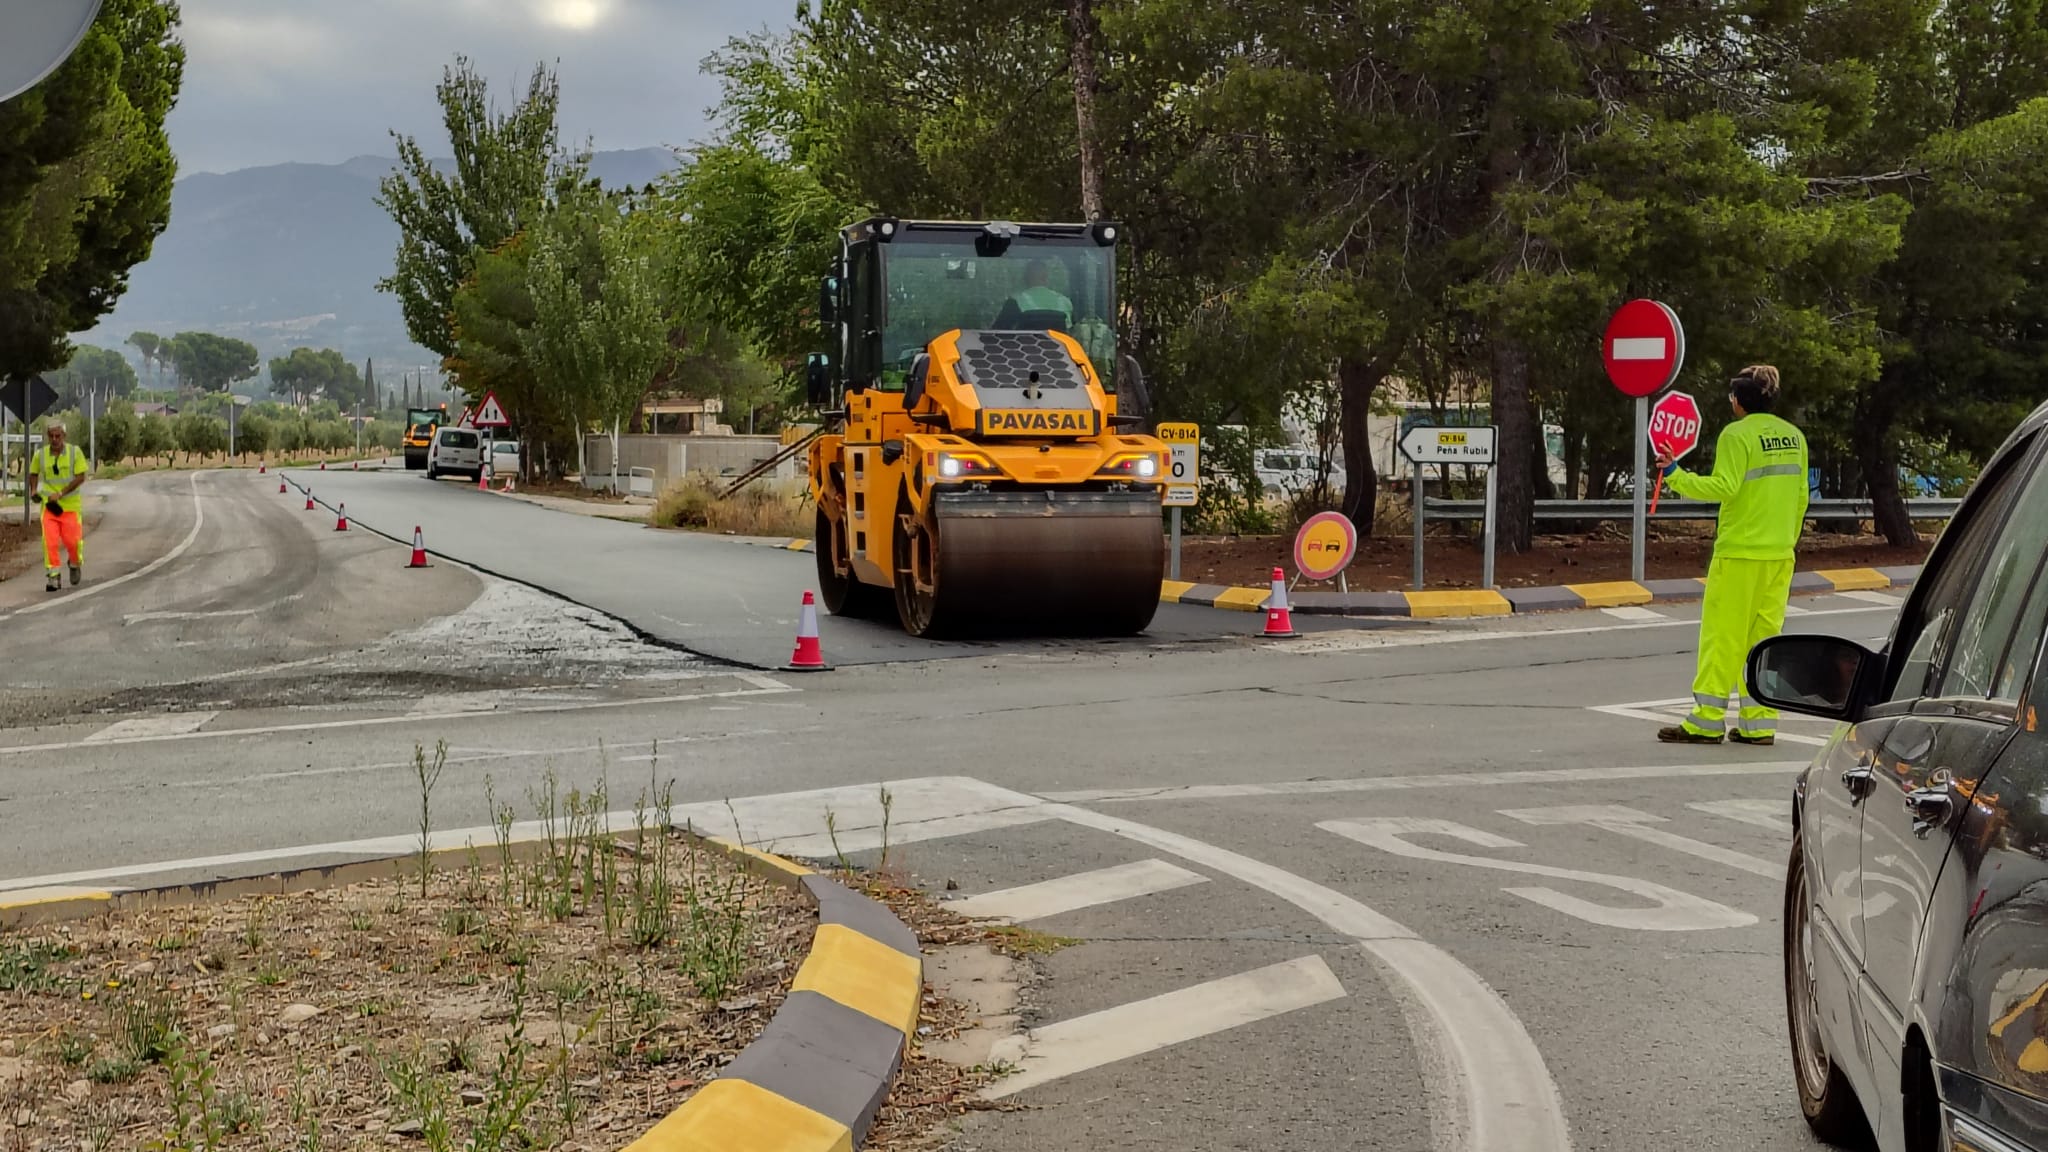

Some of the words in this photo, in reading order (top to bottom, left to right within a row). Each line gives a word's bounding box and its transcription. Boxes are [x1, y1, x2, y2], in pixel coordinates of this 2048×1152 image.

[989, 413, 1087, 429] PAVASAL
[1654, 410, 1696, 440] STOP
[1161, 428, 1197, 439] CV-814
[1436, 445, 1458, 455] Peña
[1463, 446, 1488, 455] Rubia
